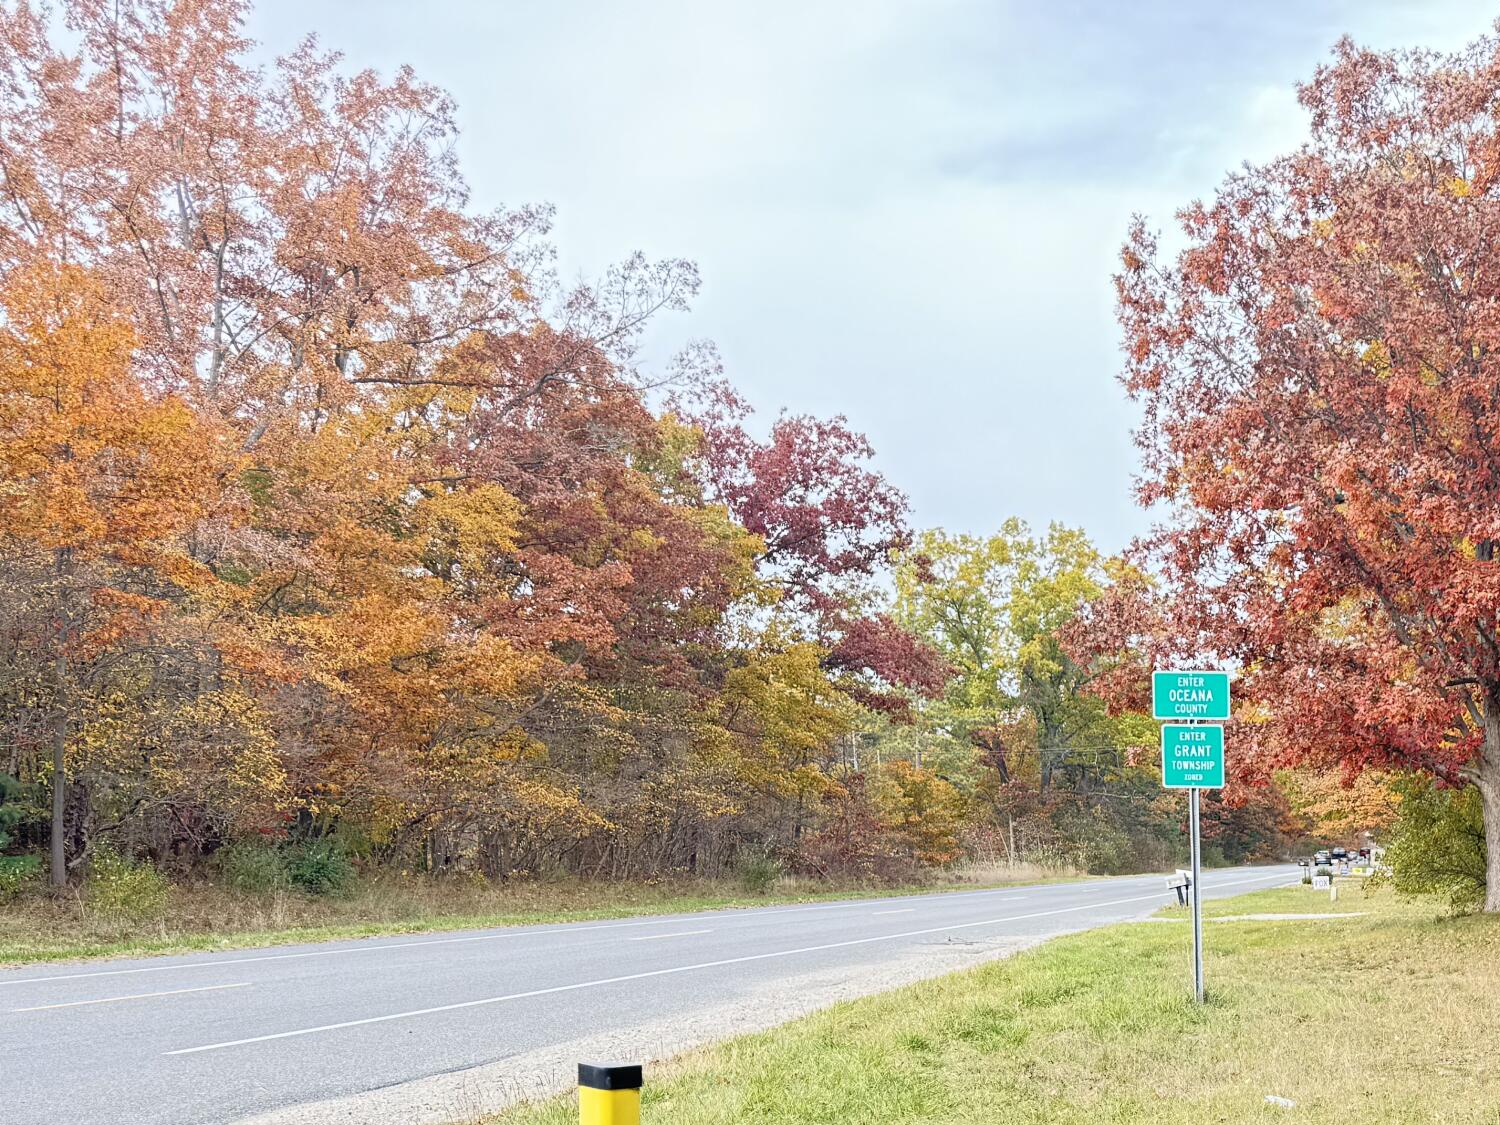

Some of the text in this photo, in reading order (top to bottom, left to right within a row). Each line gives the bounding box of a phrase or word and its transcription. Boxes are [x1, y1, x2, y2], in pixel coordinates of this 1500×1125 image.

[1178, 677, 1204, 687] ENTER
[1169, 690, 1213, 702] OCEANA
[1175, 704, 1208, 713] COUNTY
[1179, 732, 1206, 741] ENTER
[1175, 745, 1212, 757] GRANT
[1172, 761, 1215, 770] TOWNSHIP
[1184, 773, 1203, 781] ZONED
